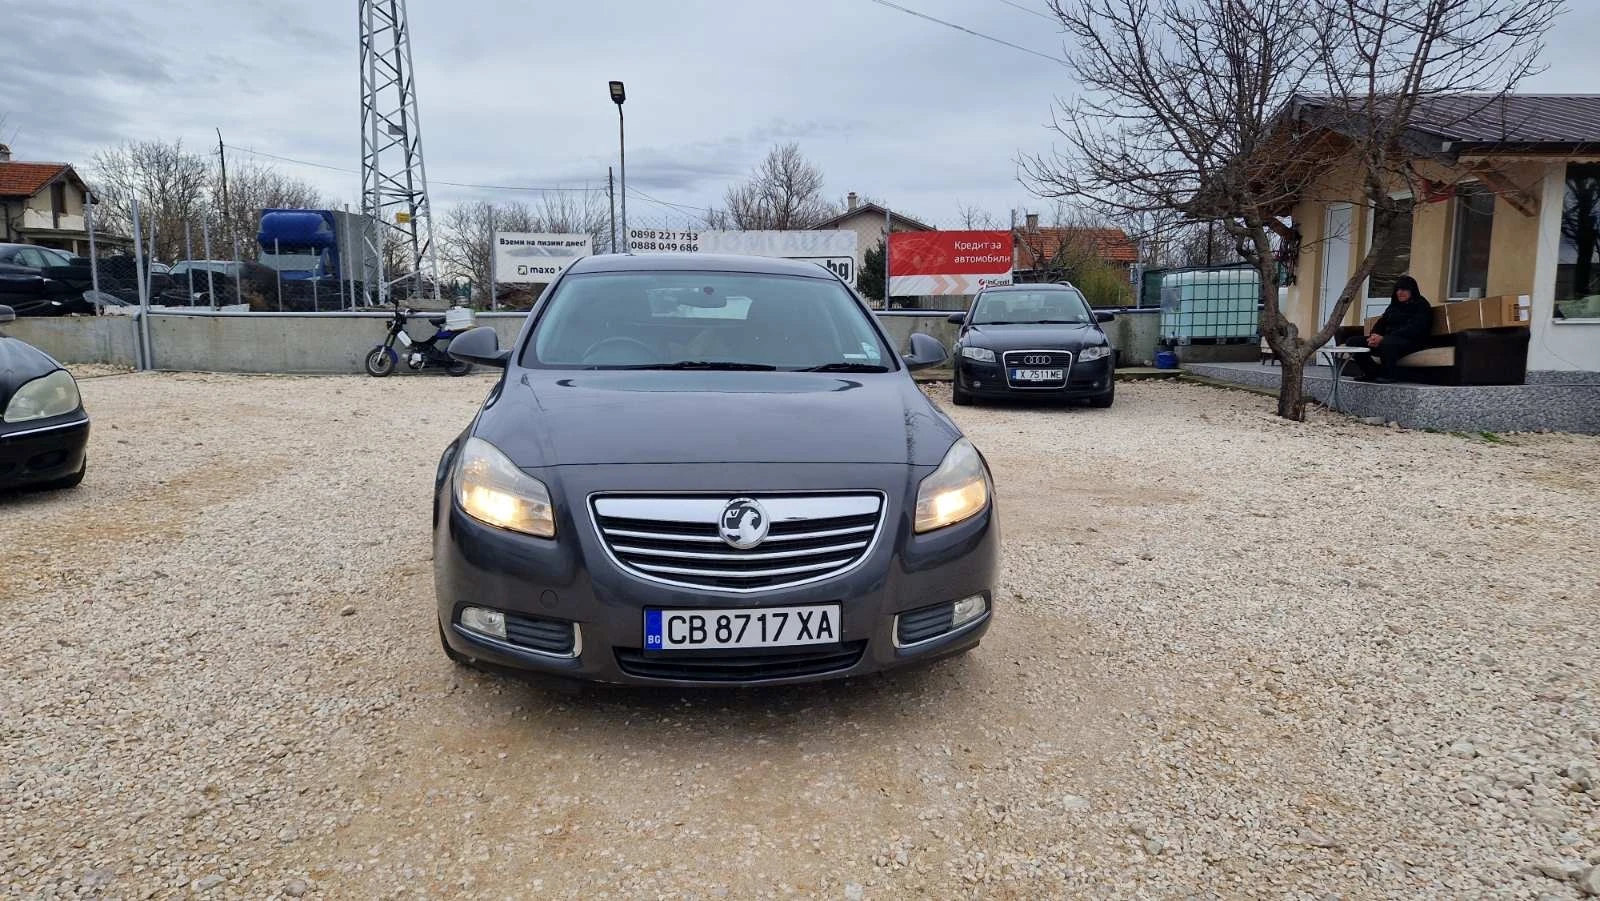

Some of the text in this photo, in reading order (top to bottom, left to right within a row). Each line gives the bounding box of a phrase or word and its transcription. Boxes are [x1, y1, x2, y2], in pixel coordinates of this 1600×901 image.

[631, 230, 656, 239] 0898
[659, 231, 676, 240] 221
[680, 232, 698, 241] 753
[631, 241, 698, 252] 0888 049 686
[954, 241, 988, 251] Кредит
[954, 253, 1011, 263] автомобили
[667, 611, 833, 644] CB 8717 XA
[648, 635, 661, 644] BG
